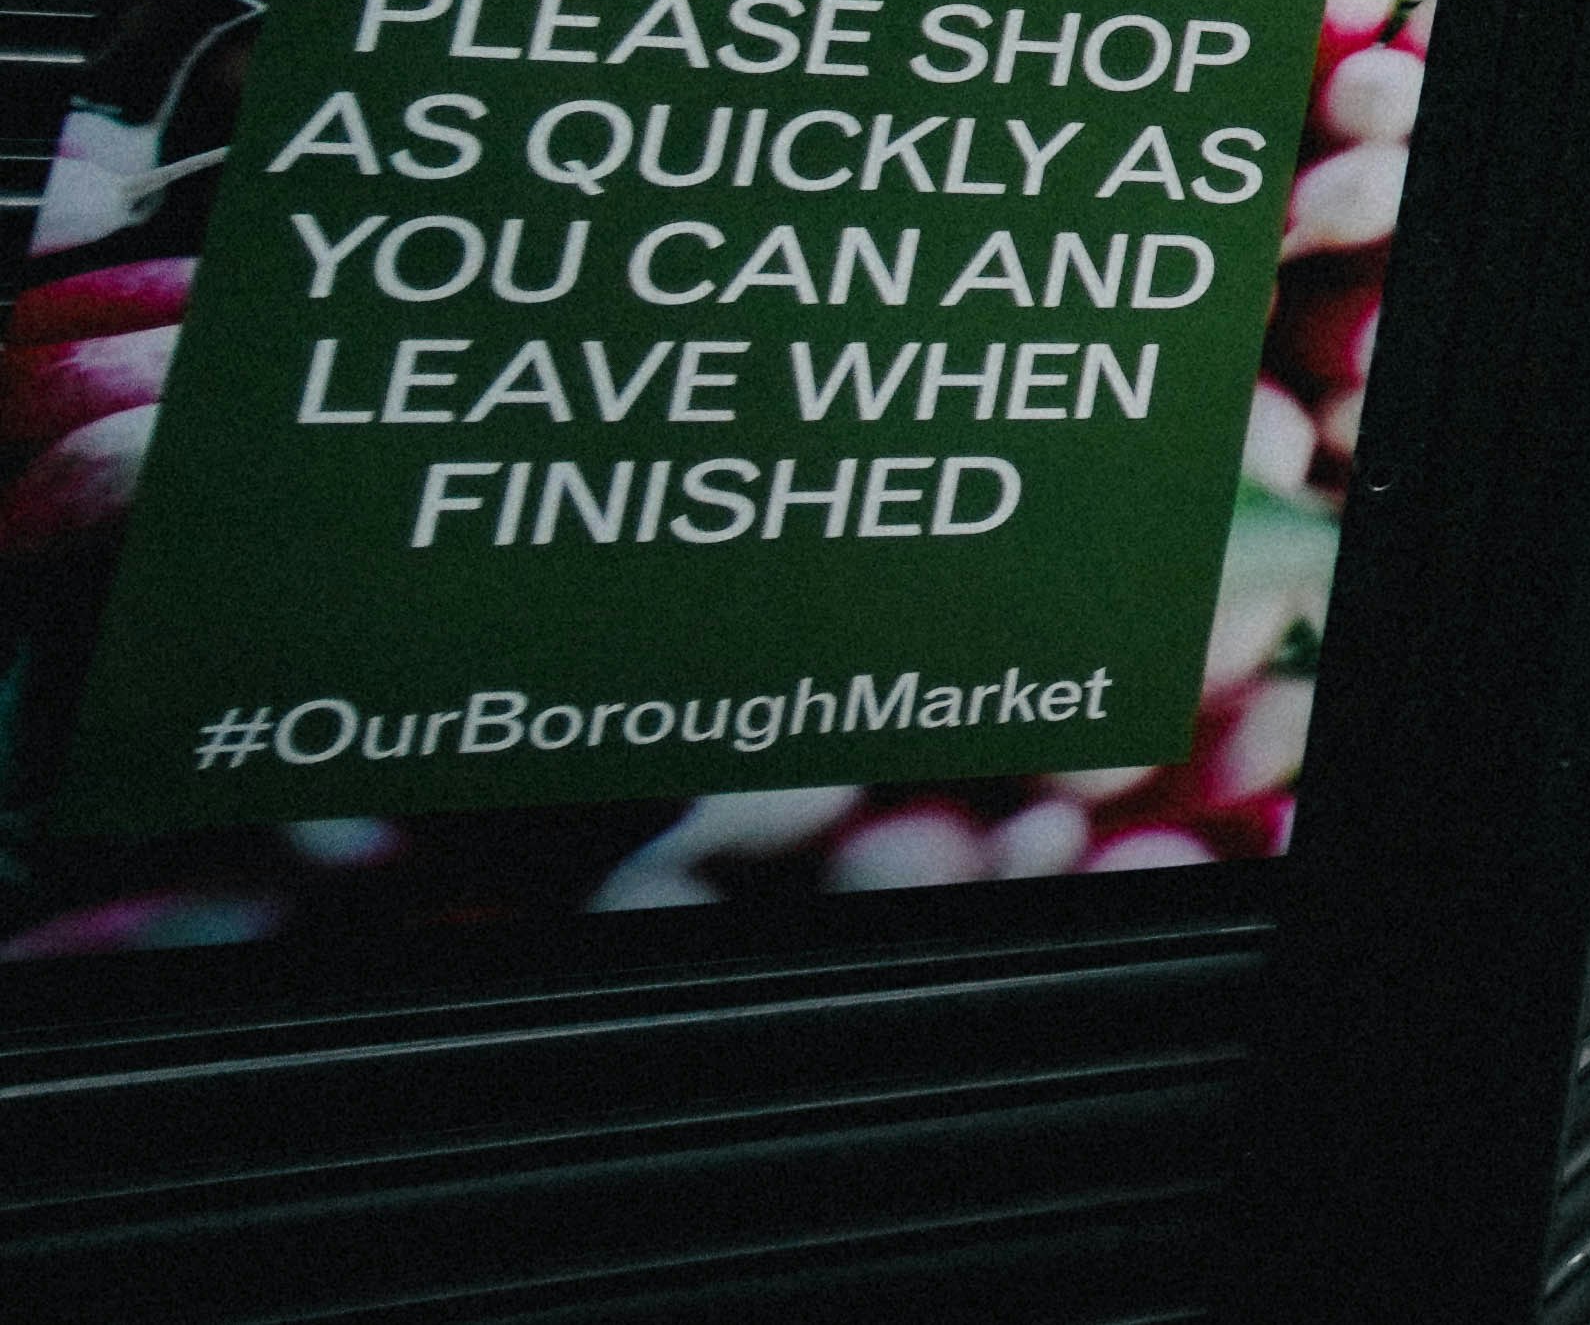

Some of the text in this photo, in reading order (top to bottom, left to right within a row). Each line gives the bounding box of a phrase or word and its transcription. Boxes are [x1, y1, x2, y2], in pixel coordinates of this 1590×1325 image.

[910, 4, 1250, 92] SHOP
[268, 92, 1266, 204] AS QUICKLY AS
[292, 214, 1214, 309] YOU CAN AND
[298, 339, 1159, 423] LEAVE WHEN
[412, 457, 1021, 547] FINISHED
[199, 668, 1112, 767] #OurBoroughMarket
